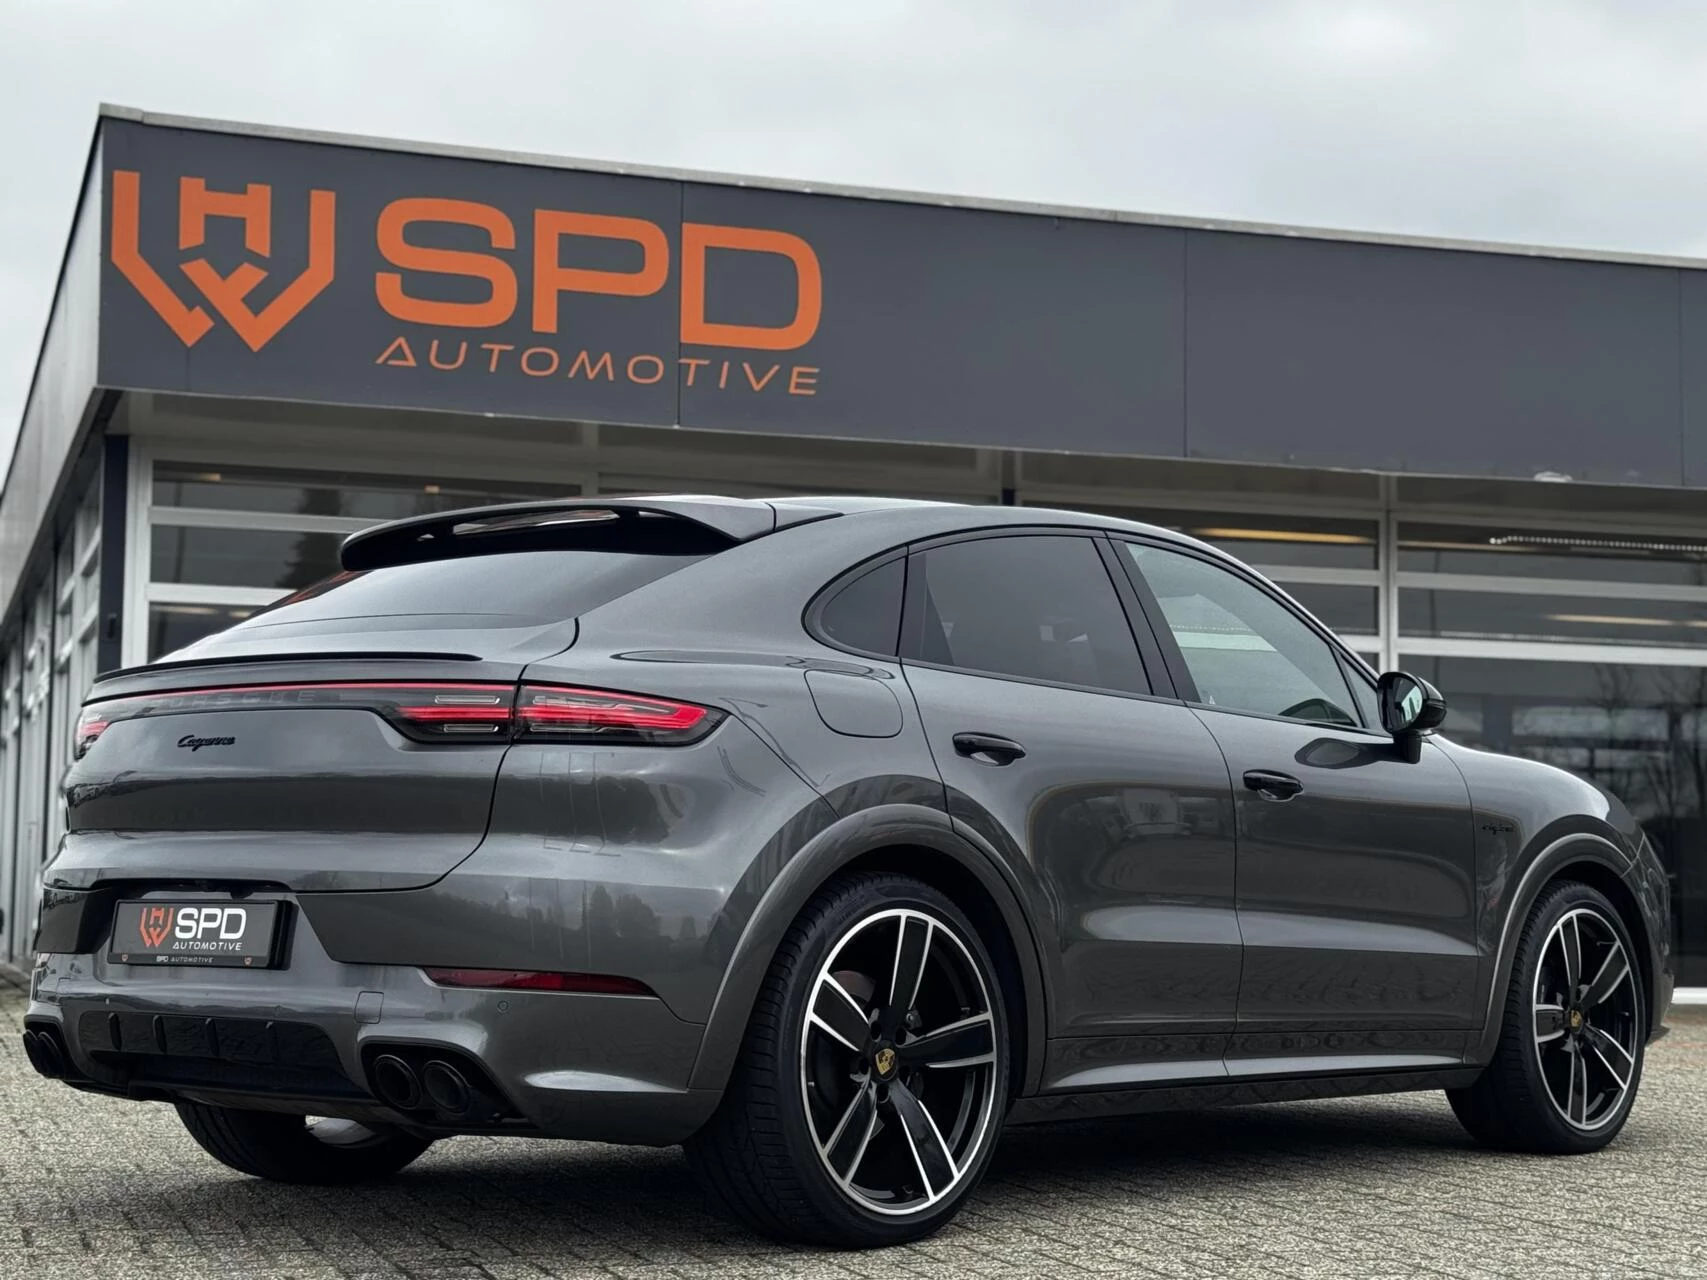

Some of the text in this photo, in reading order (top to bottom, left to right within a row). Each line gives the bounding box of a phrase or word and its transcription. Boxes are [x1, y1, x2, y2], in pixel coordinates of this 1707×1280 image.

[375, 198, 822, 350] SPD
[376, 336, 820, 396] AUTOMOTIVE
[175, 907, 246, 940] SPD
[170, 956, 214, 964] AUTOMOTIVE
[173, 941, 243, 951] AUTOMOTIVE
